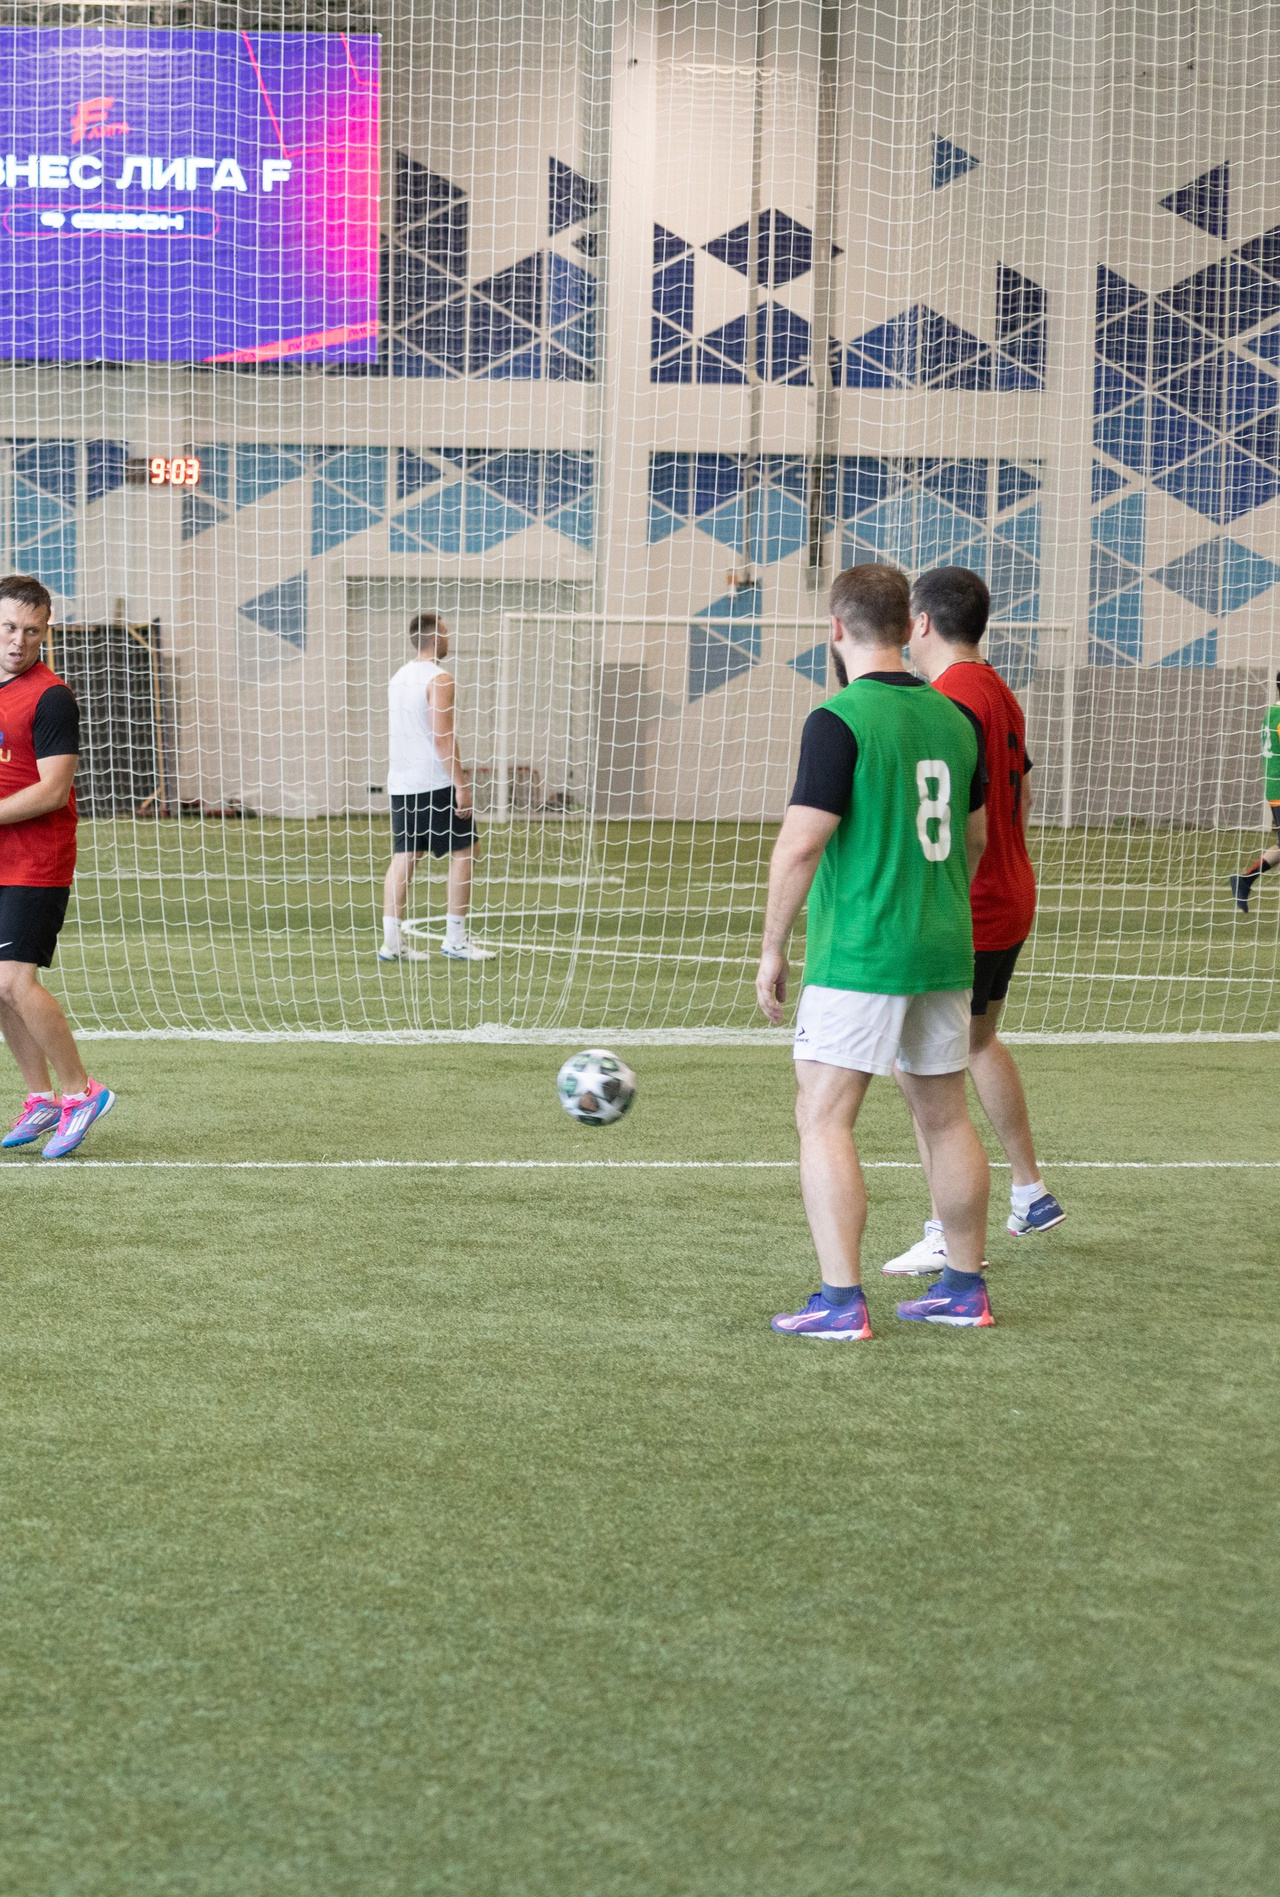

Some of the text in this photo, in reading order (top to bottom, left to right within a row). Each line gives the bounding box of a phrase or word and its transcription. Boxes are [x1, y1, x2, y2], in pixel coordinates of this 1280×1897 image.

[115, 157, 248, 192] ЛИГА
[262, 159, 292, 192] F
[150, 457, 200, 485] 9:03
[915, 759, 951, 862] 8
